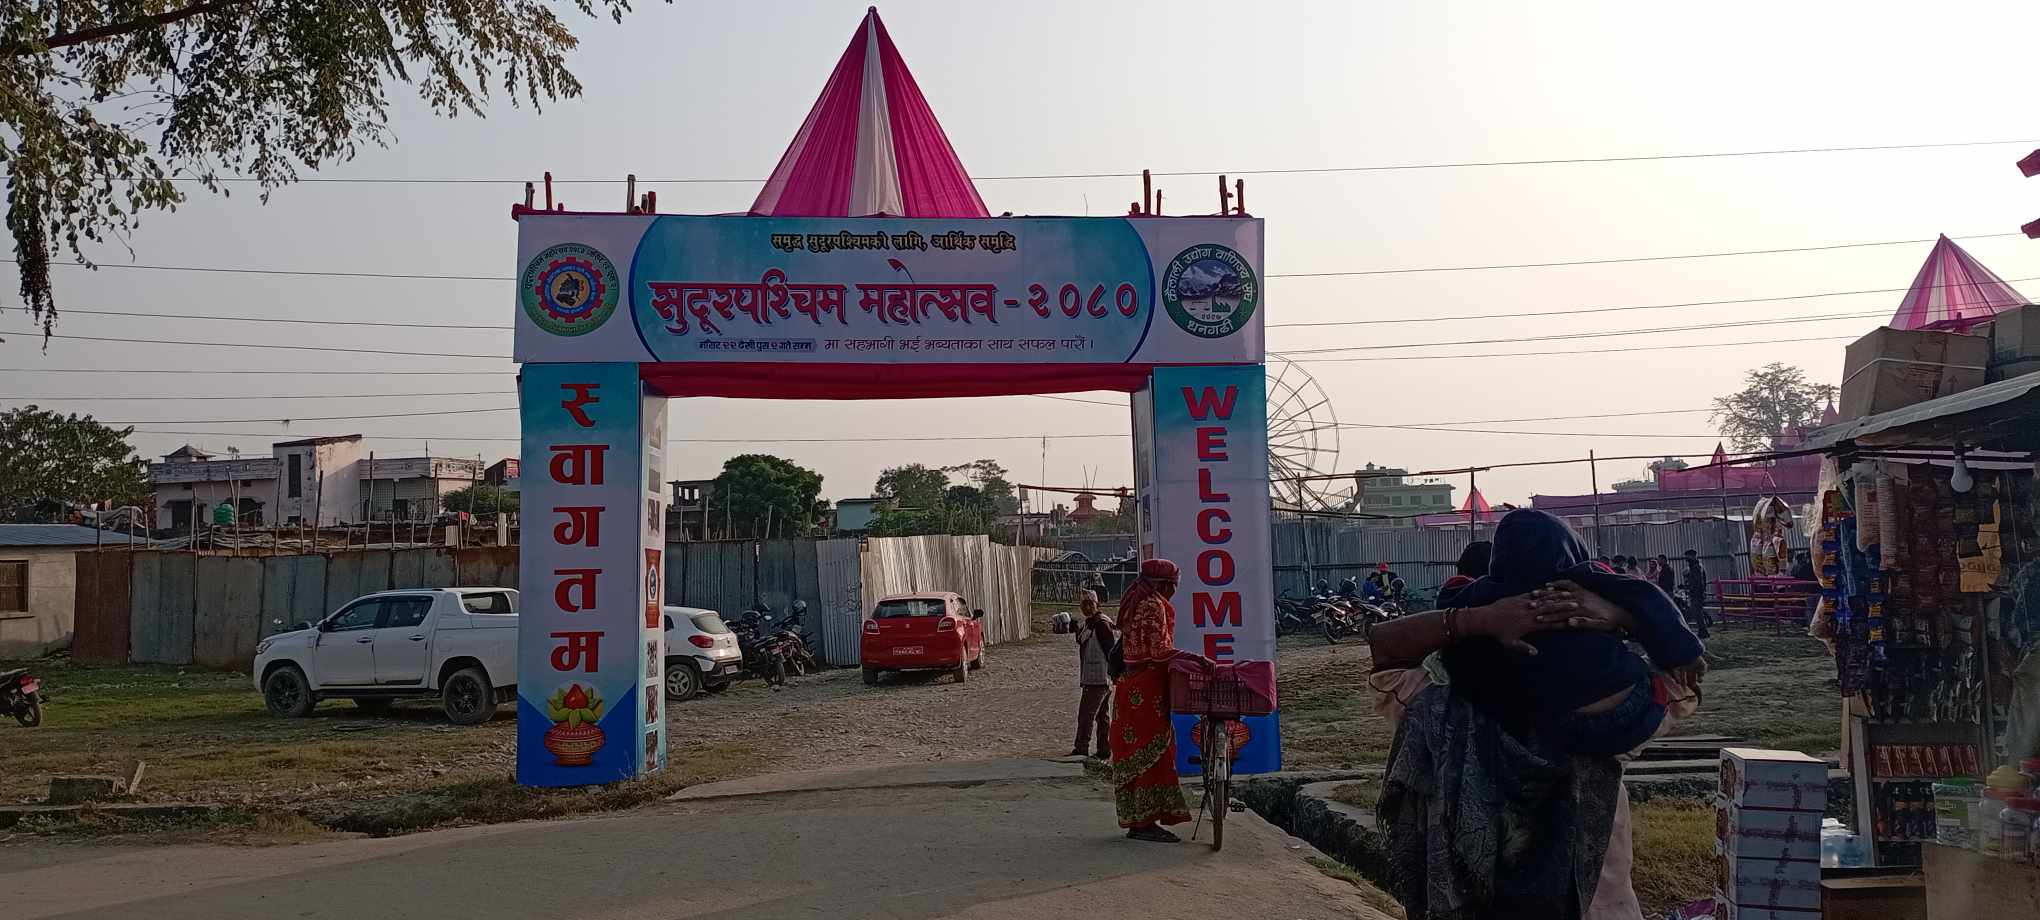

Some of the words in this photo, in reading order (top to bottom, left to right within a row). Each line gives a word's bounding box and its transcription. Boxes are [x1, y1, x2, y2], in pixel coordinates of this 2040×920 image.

[931, 231, 976, 251] आर्थिक
[979, 231, 1016, 253] समृद्धि
[648, 268, 848, 336] सुदूरपश्चिम
[855, 259, 1000, 325] महोत्सव
[1027, 282, 1139, 320] २०८०
[1181, 384, 1242, 666] WELCOME
